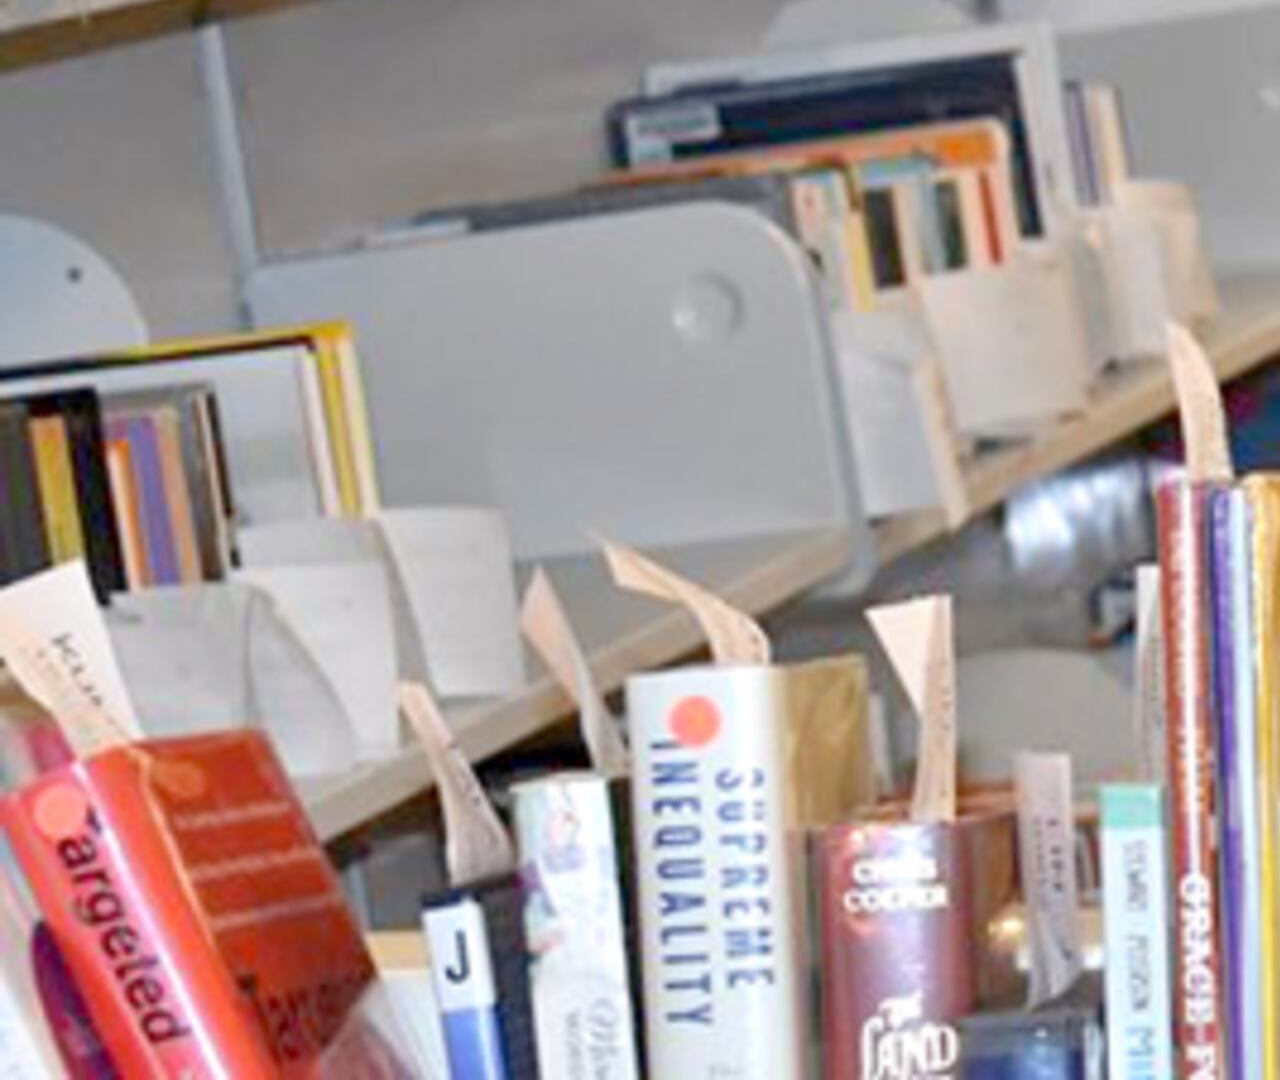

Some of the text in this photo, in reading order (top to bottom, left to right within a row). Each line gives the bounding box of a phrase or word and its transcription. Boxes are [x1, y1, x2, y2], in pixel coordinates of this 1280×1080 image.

[445, 930, 471, 984] J
[649, 738, 714, 1028] INEQUALITY
[714, 766, 776, 990] SUPREME
[1178, 872, 1215, 1023] GRACE
